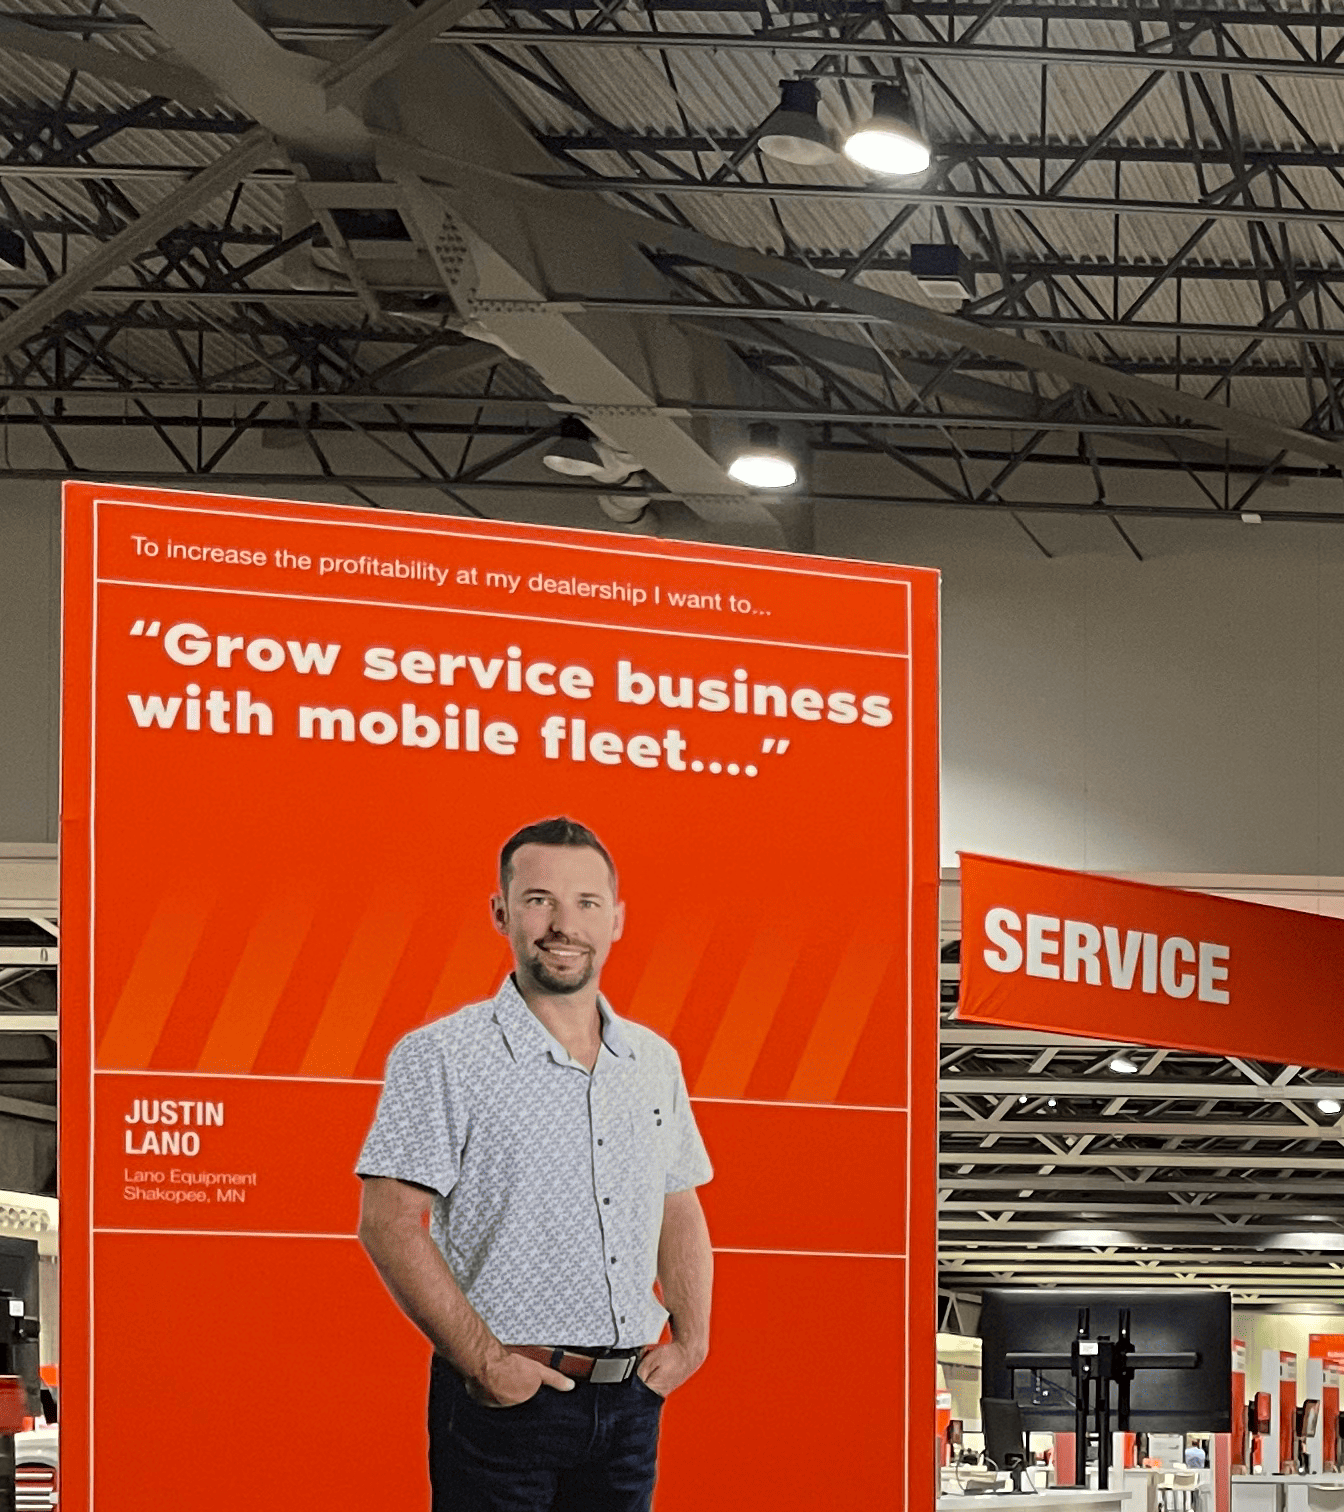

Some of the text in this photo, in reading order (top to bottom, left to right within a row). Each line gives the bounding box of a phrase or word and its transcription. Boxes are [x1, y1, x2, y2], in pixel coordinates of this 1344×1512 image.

[131, 536, 158, 556] To
[168, 539, 266, 566] increase
[275, 550, 311, 569] the
[320, 556, 448, 586] profitability
[456, 568, 477, 585] at
[486, 573, 520, 593] my
[529, 574, 646, 606] dealership
[655, 586, 659, 604] I
[668, 593, 721, 610] want
[364, 646, 594, 698] service
[618, 660, 892, 727] business
[128, 684, 272, 735] with
[299, 703, 518, 754] mobile
[982, 907, 1230, 1005] SERVICE
[125, 1099, 224, 1126] JUSTIN
[125, 1130, 200, 1156] LANO
[124, 1186, 245, 1203] Shakopee, MN
[125, 1168, 257, 1186] Lano Equipment
